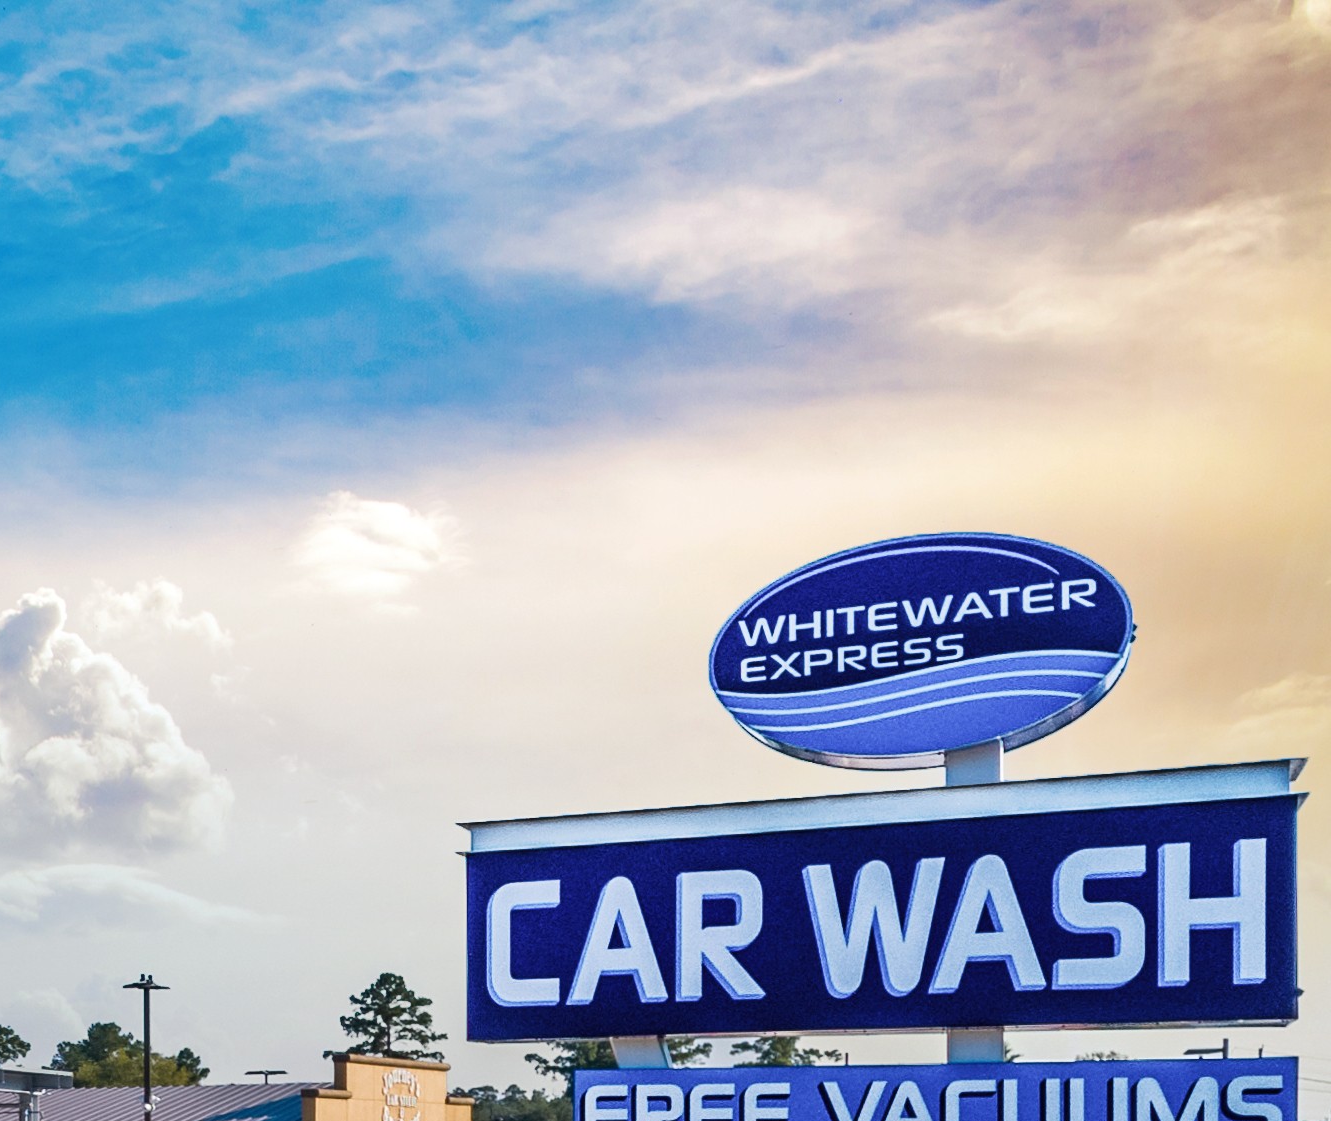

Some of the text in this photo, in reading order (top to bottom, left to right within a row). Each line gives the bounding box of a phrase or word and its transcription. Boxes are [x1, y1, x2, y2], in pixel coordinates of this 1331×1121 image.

[738, 578, 1098, 647] WHITEWATER
[740, 633, 965, 684] EXPRESS
[486, 837, 1268, 1008] CAR WASH
